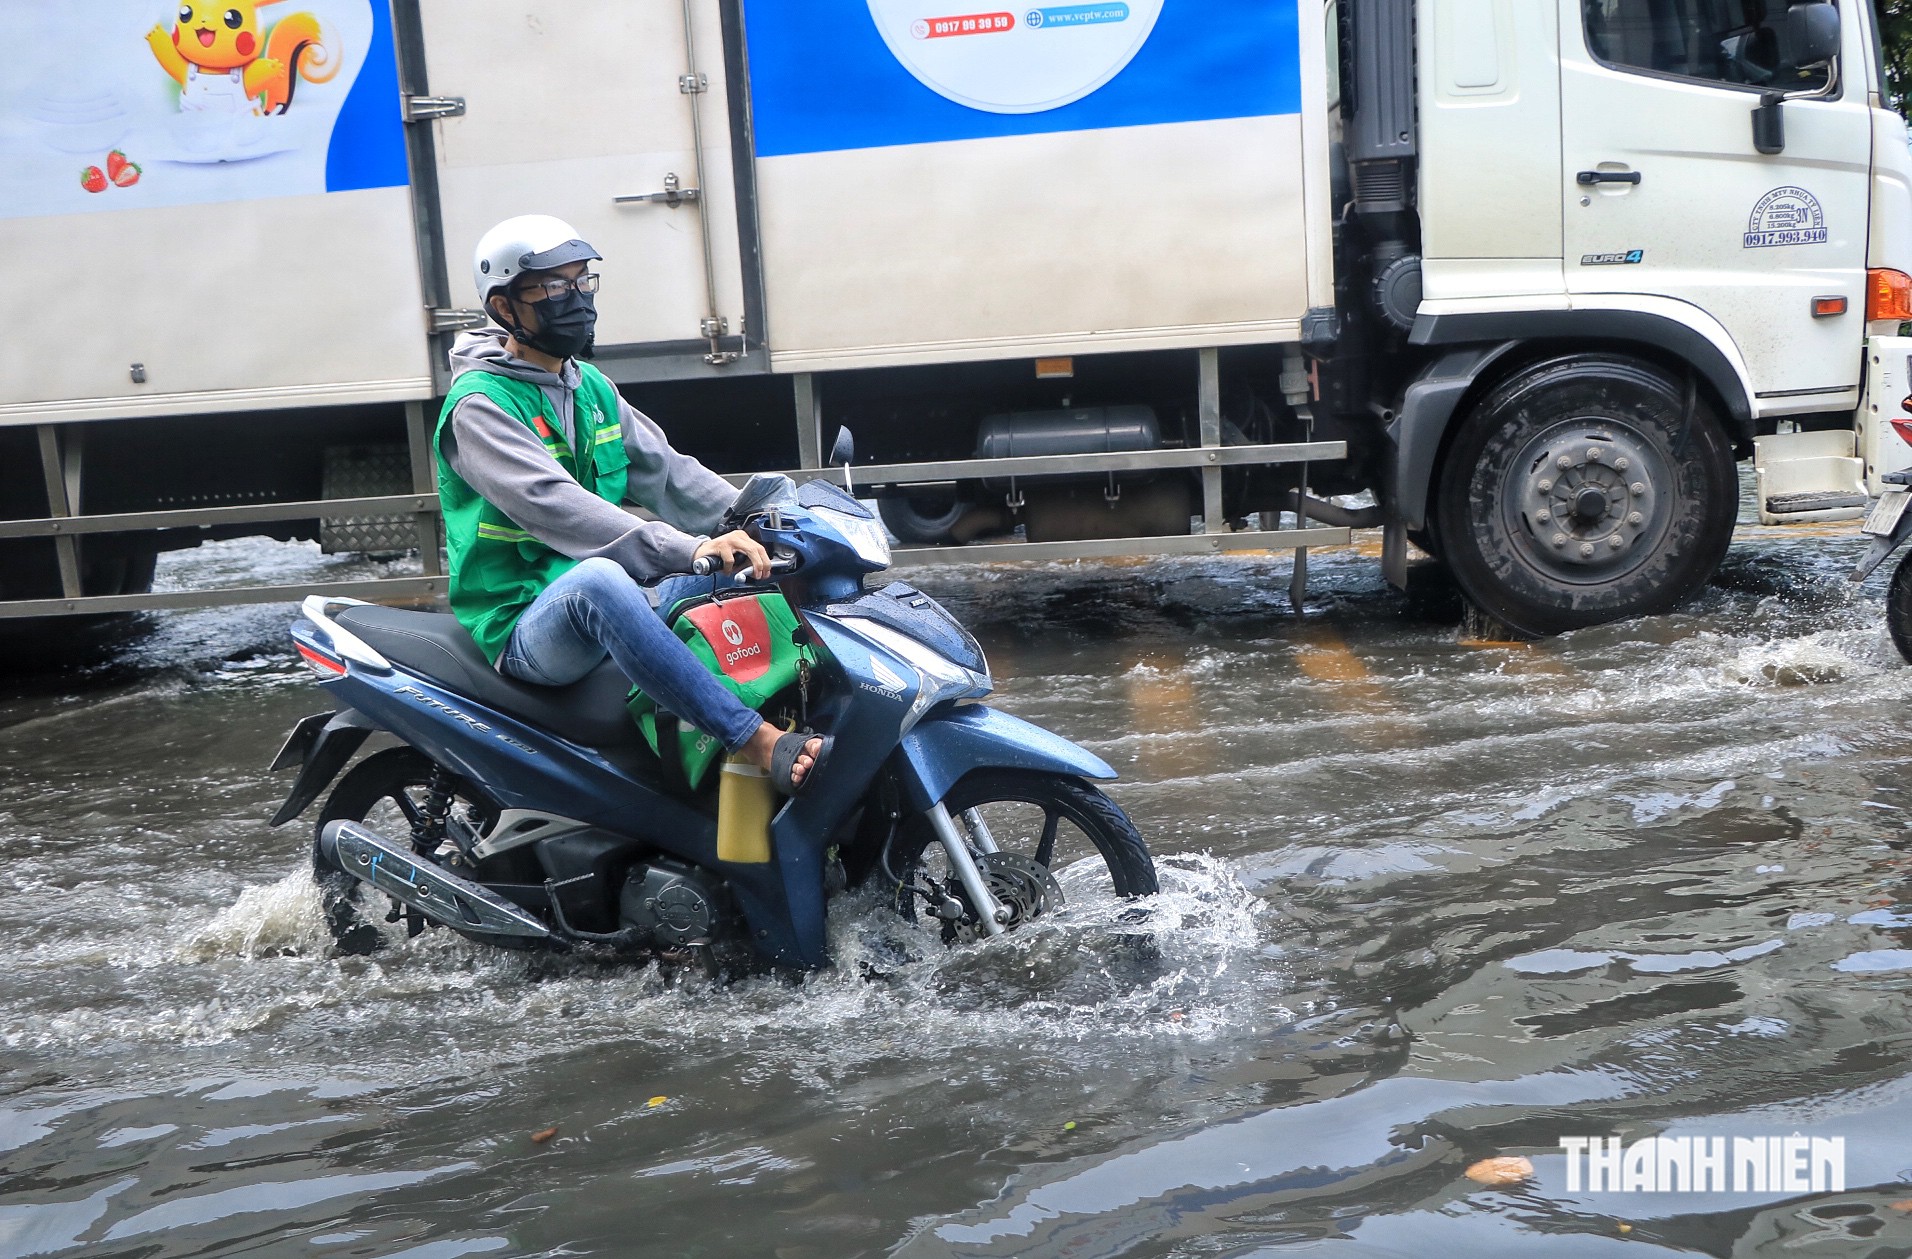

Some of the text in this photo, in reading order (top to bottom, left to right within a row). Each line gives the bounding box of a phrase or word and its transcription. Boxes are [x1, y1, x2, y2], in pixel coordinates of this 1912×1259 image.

[935, 20, 960, 34] 0917
[962, 19, 976, 31] 99
[978, 18, 992, 30] 39
[1049, 9, 1125, 22] www.vcptw.com
[1756, 197, 1772, 215] TNHH
[1772, 189, 1788, 198] MTV
[1746, 230, 1826, 246] 0917.993.940
[726, 643, 761, 665] gofood
[859, 682, 904, 703] HONDA
[393, 685, 492, 734] FUTURE
